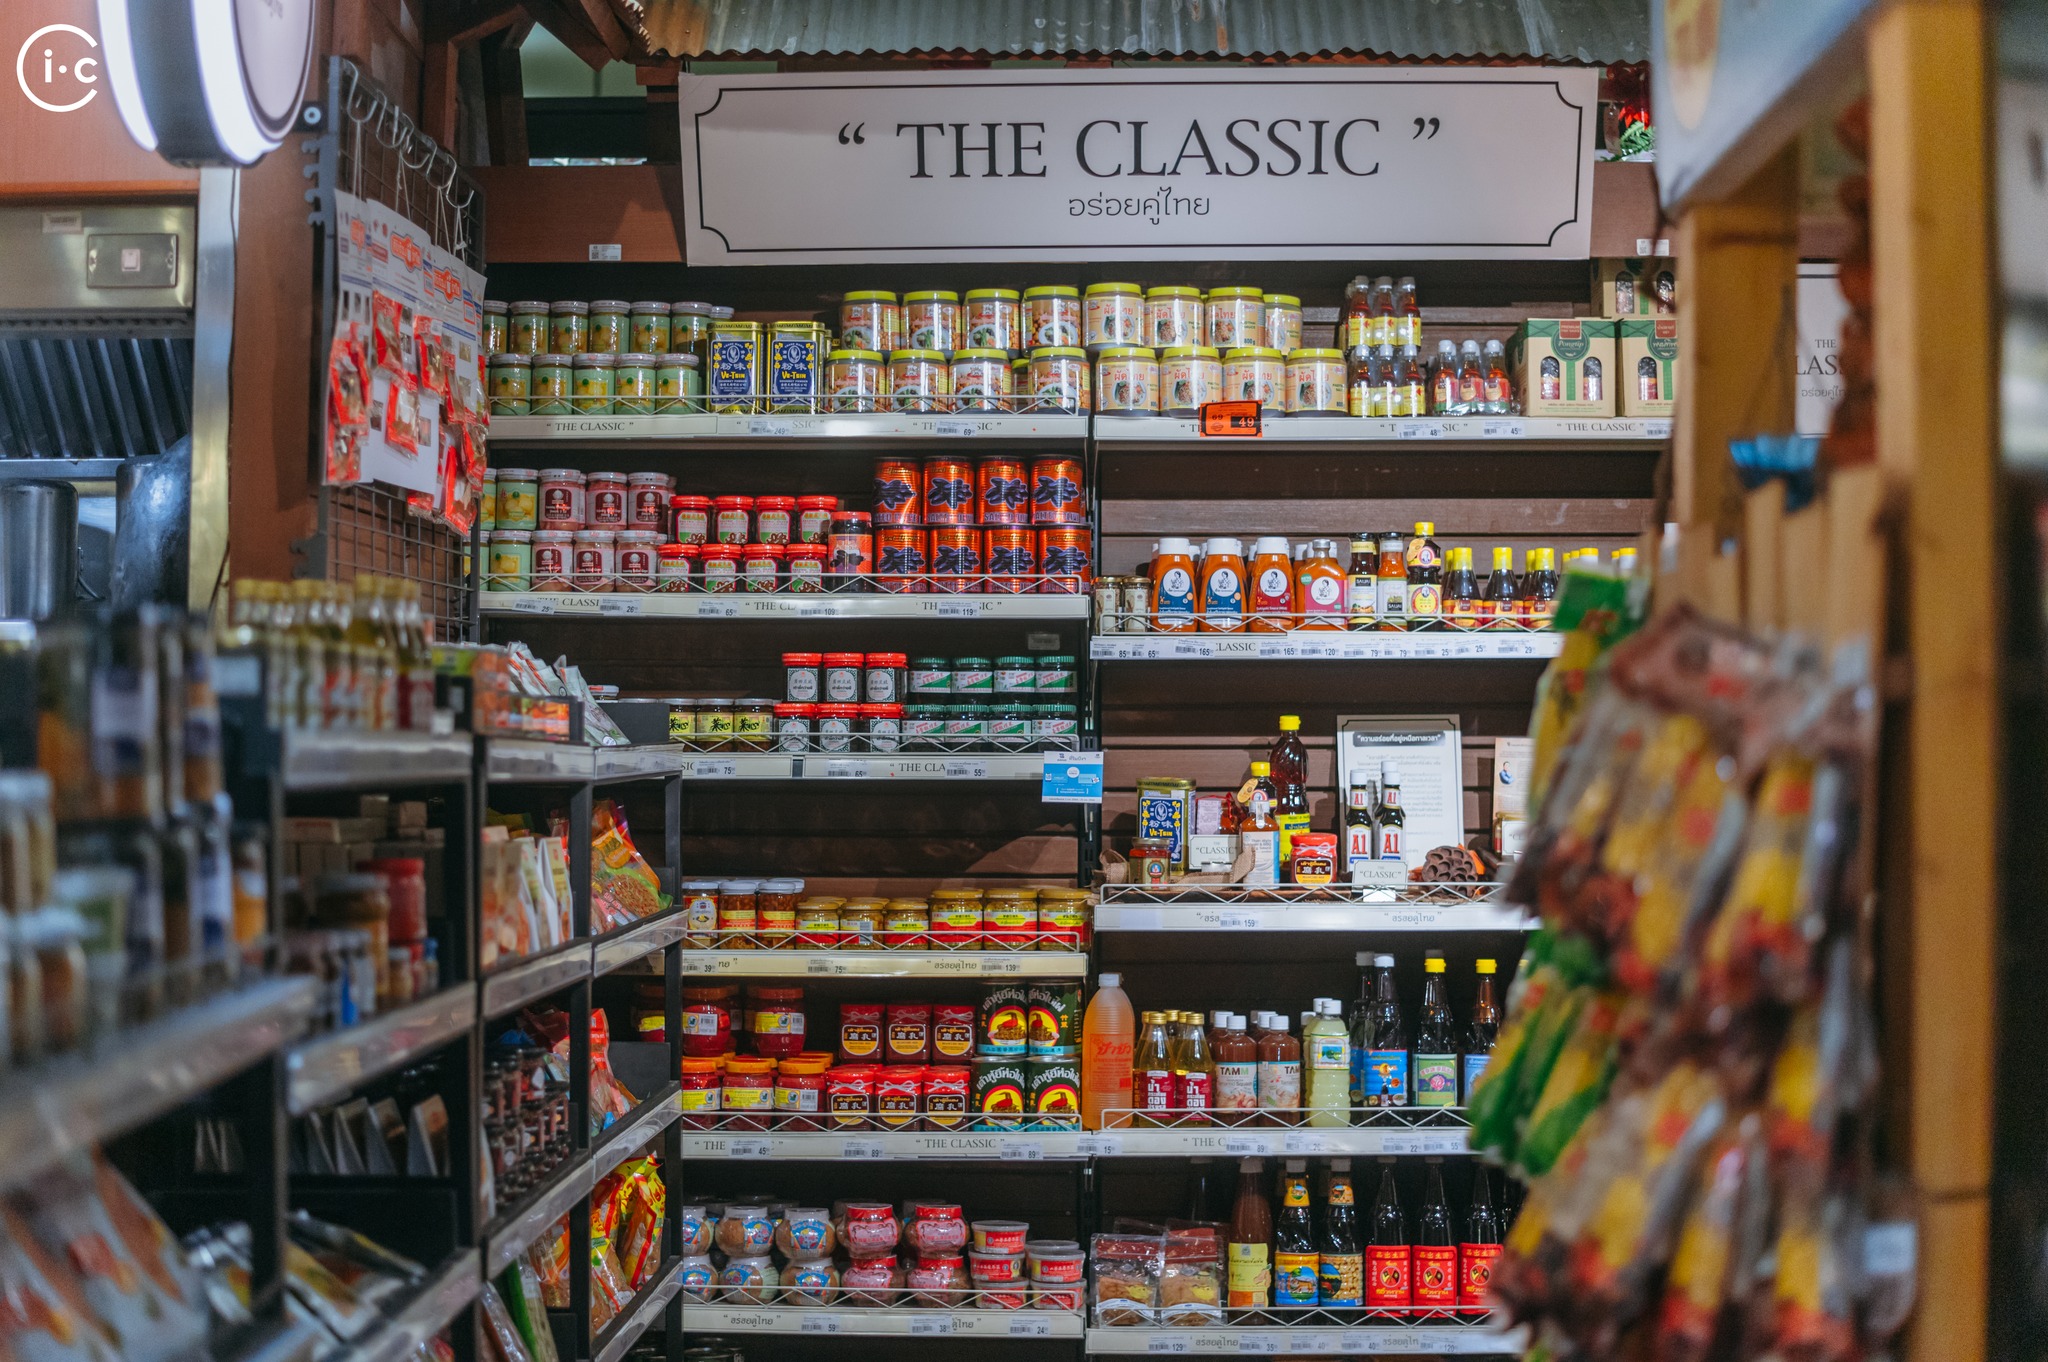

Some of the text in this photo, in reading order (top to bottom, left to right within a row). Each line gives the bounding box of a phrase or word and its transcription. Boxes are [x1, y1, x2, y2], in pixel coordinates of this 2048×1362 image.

[896, 121, 1047, 179] THE
[1075, 117, 1382, 179] CLASSIC
[1068, 186, 1211, 225] อร่อยคู่ไทย
[1815, 339, 1837, 349] THE
[1801, 385, 1846, 400] อร่อยคู่ไท
[555, 422, 626, 432] THE CLASSIC
[792, 420, 816, 429] SSIC
[1239, 417, 1255, 428] 49
[1566, 422, 1636, 432] THE CLASSIC
[562, 598, 600, 607] CLASSI
[753, 602, 777, 611] THE
[921, 602, 938, 610] TH
[898, 763, 923, 772] THE
[1351, 834, 1367, 854] A1
[1383, 833, 1400, 854] A1
[1220, 1067, 1249, 1076] TAMM
[1284, 1066, 1300, 1074] TAM
[703, 1141, 726, 1151] THE
[924, 1138, 997, 1149] THE CLASSIC
[1191, 1137, 1215, 1147] THE
